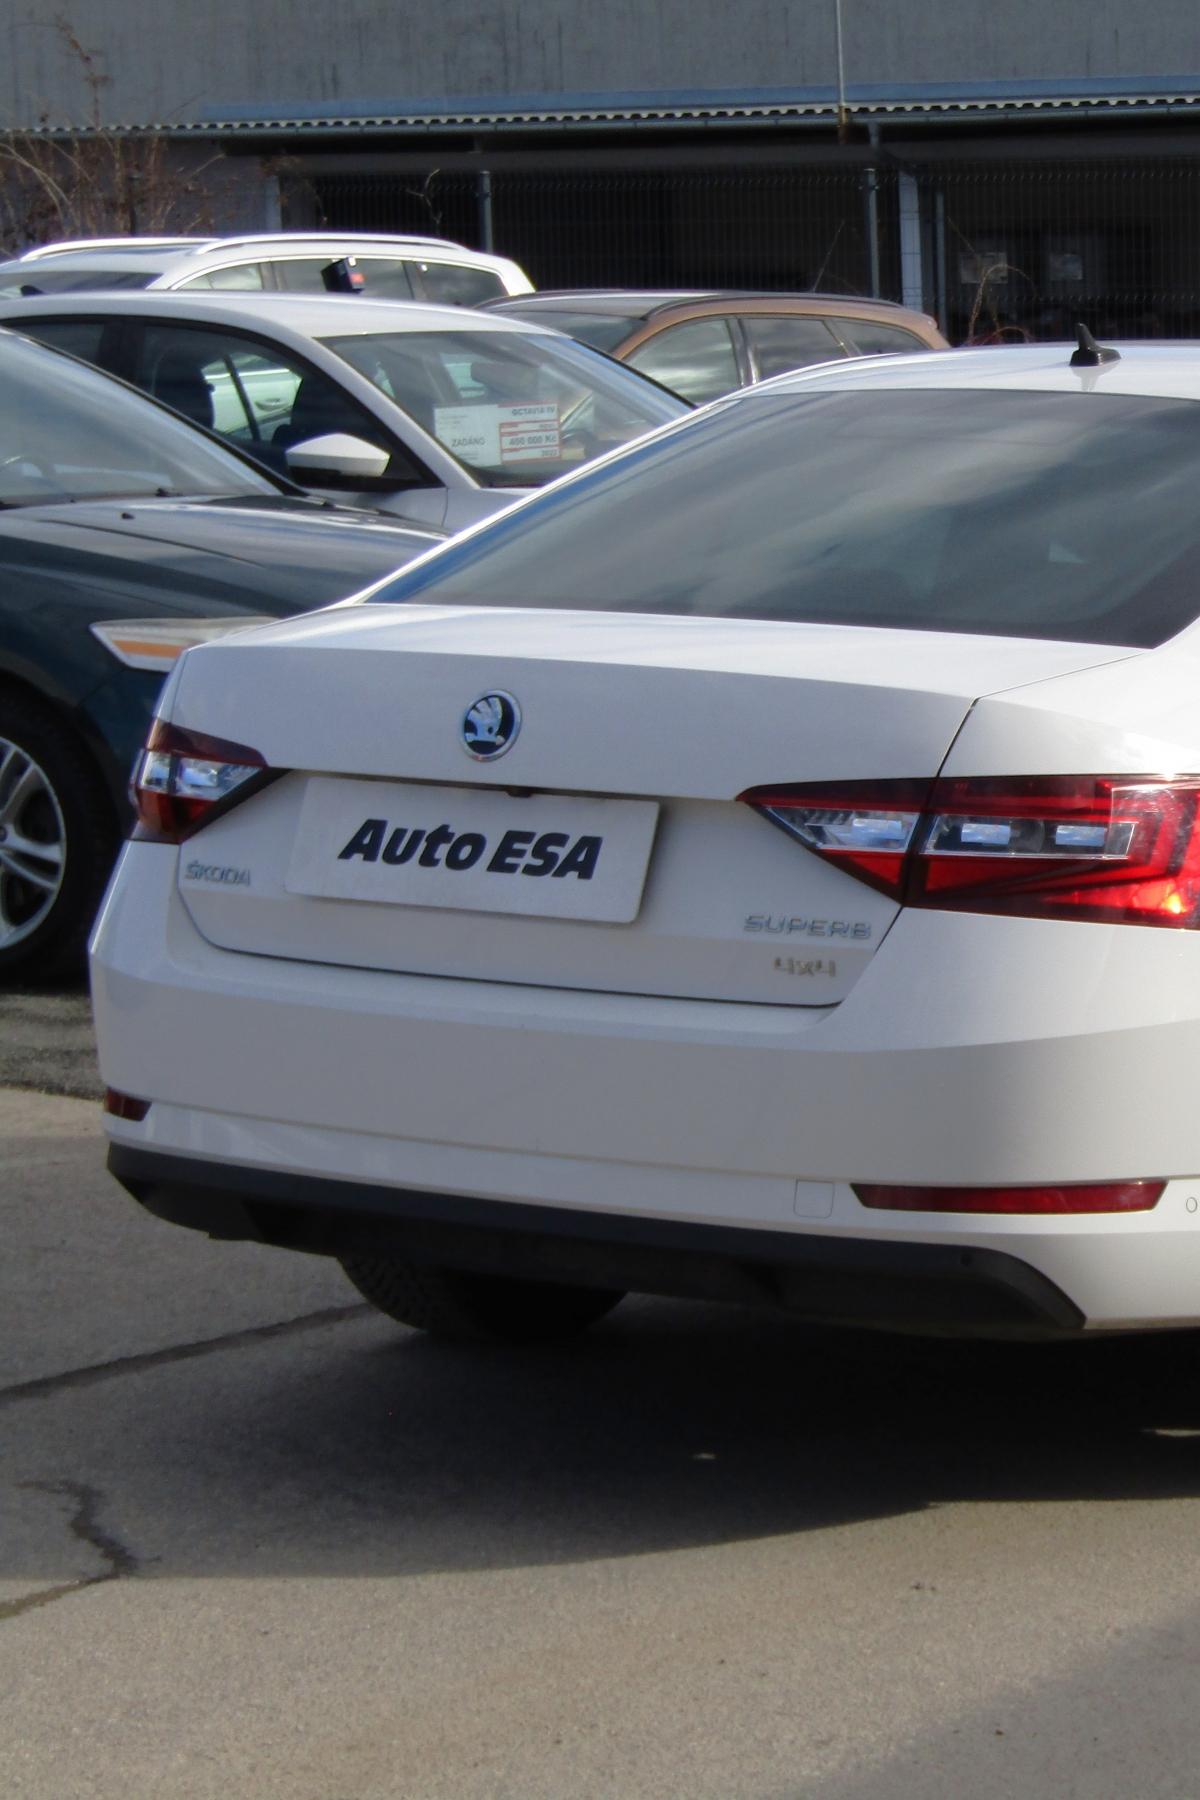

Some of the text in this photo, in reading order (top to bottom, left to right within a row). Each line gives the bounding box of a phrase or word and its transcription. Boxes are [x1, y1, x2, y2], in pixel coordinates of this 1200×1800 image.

[337, 819, 603, 880] Auto ESA
[185, 860, 251, 886] ŠKODA
[743, 913, 872, 940] SUPERB
